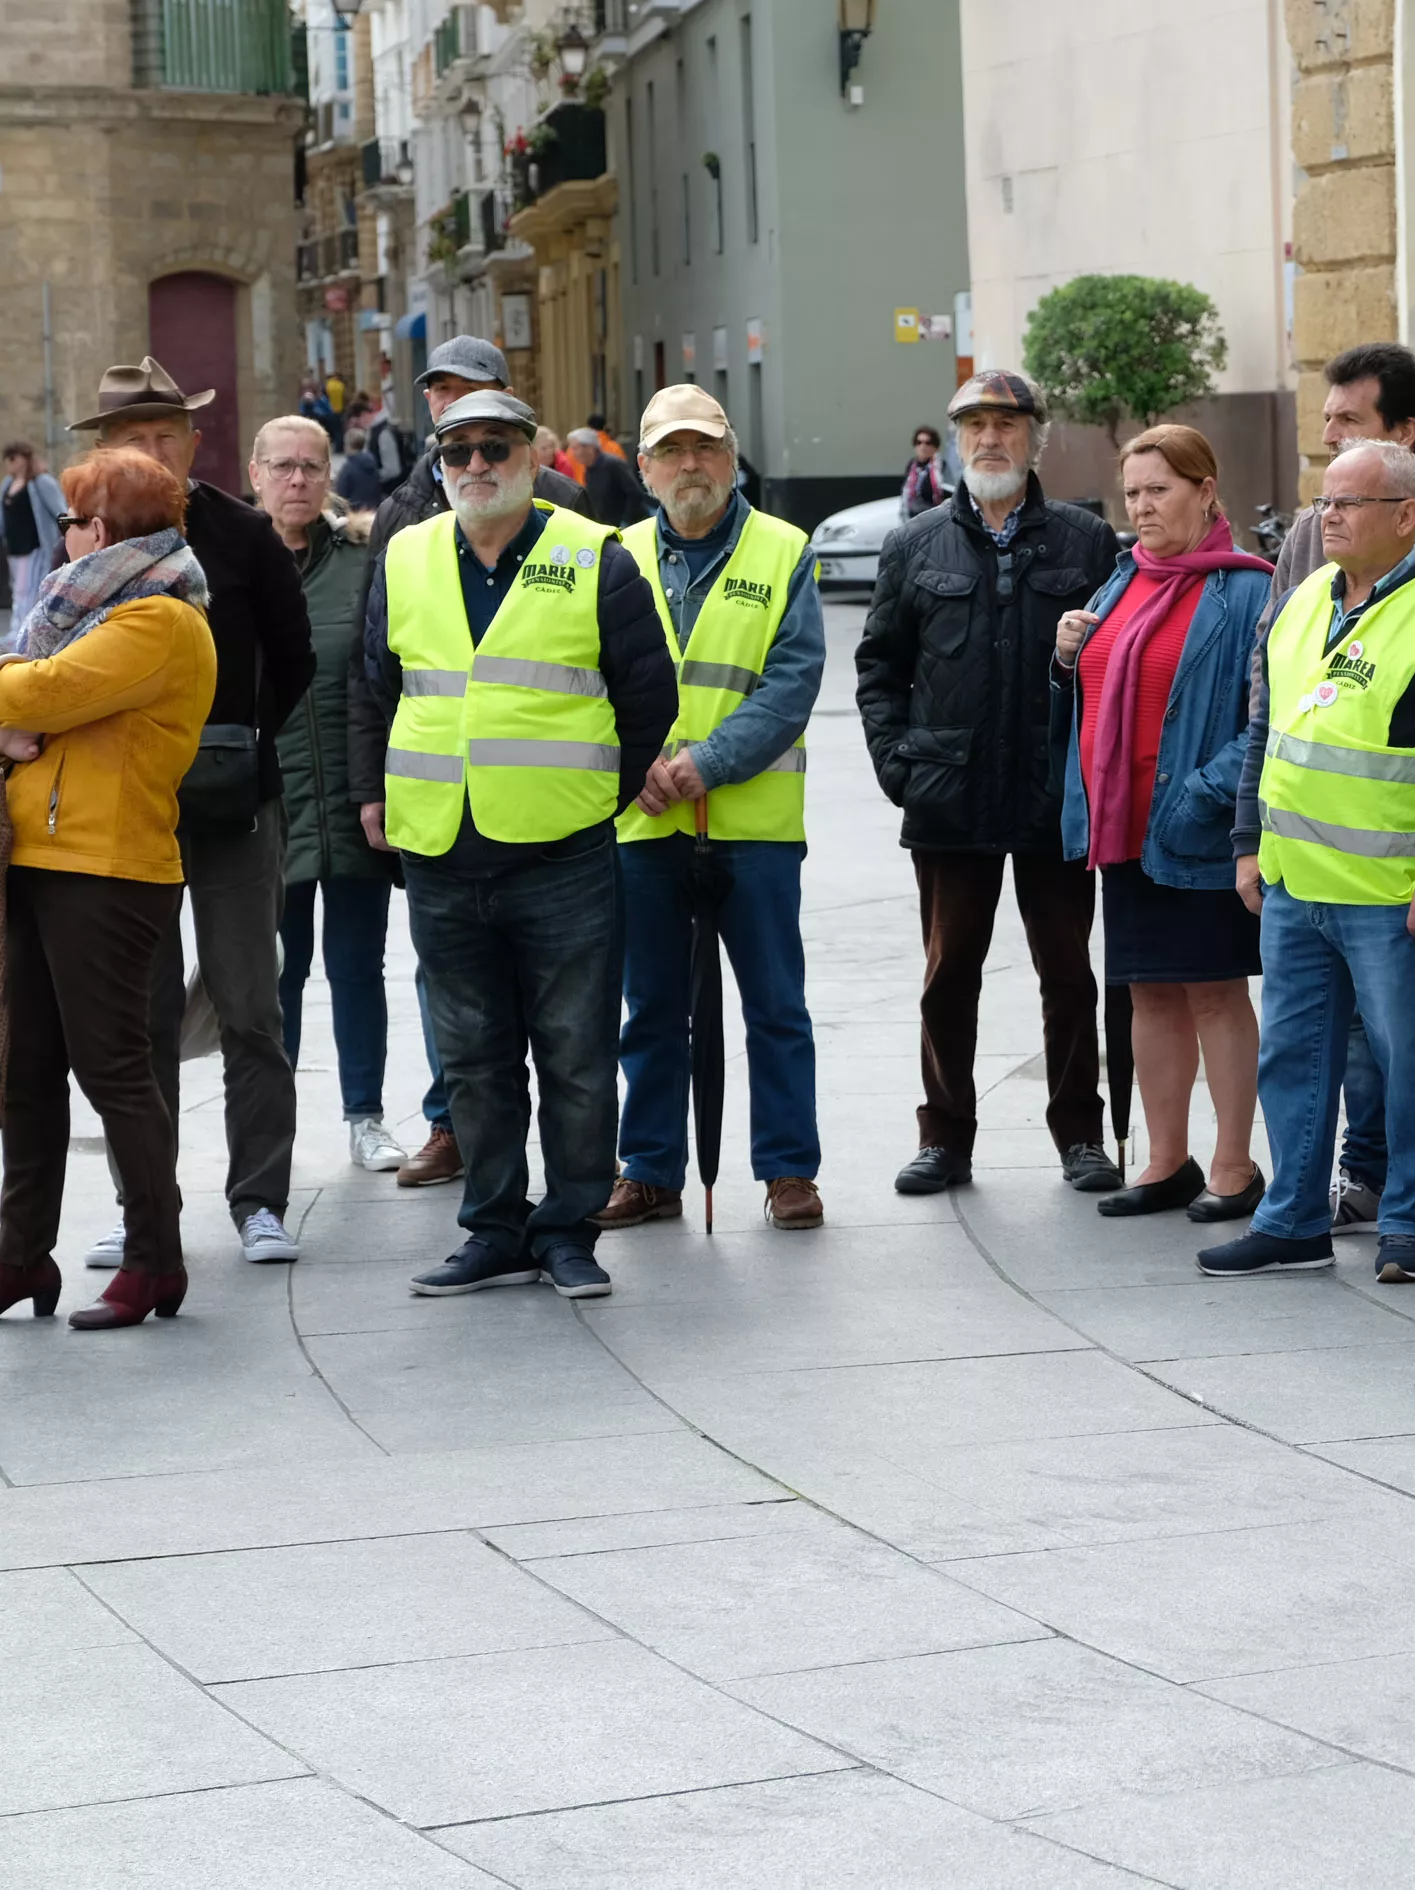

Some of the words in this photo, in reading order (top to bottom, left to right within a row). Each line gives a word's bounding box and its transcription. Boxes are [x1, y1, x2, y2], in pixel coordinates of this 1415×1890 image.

[522, 564, 576, 585] MAREA
[724, 577, 772, 603] MAREA
[1328, 652, 1377, 682] MAREA
